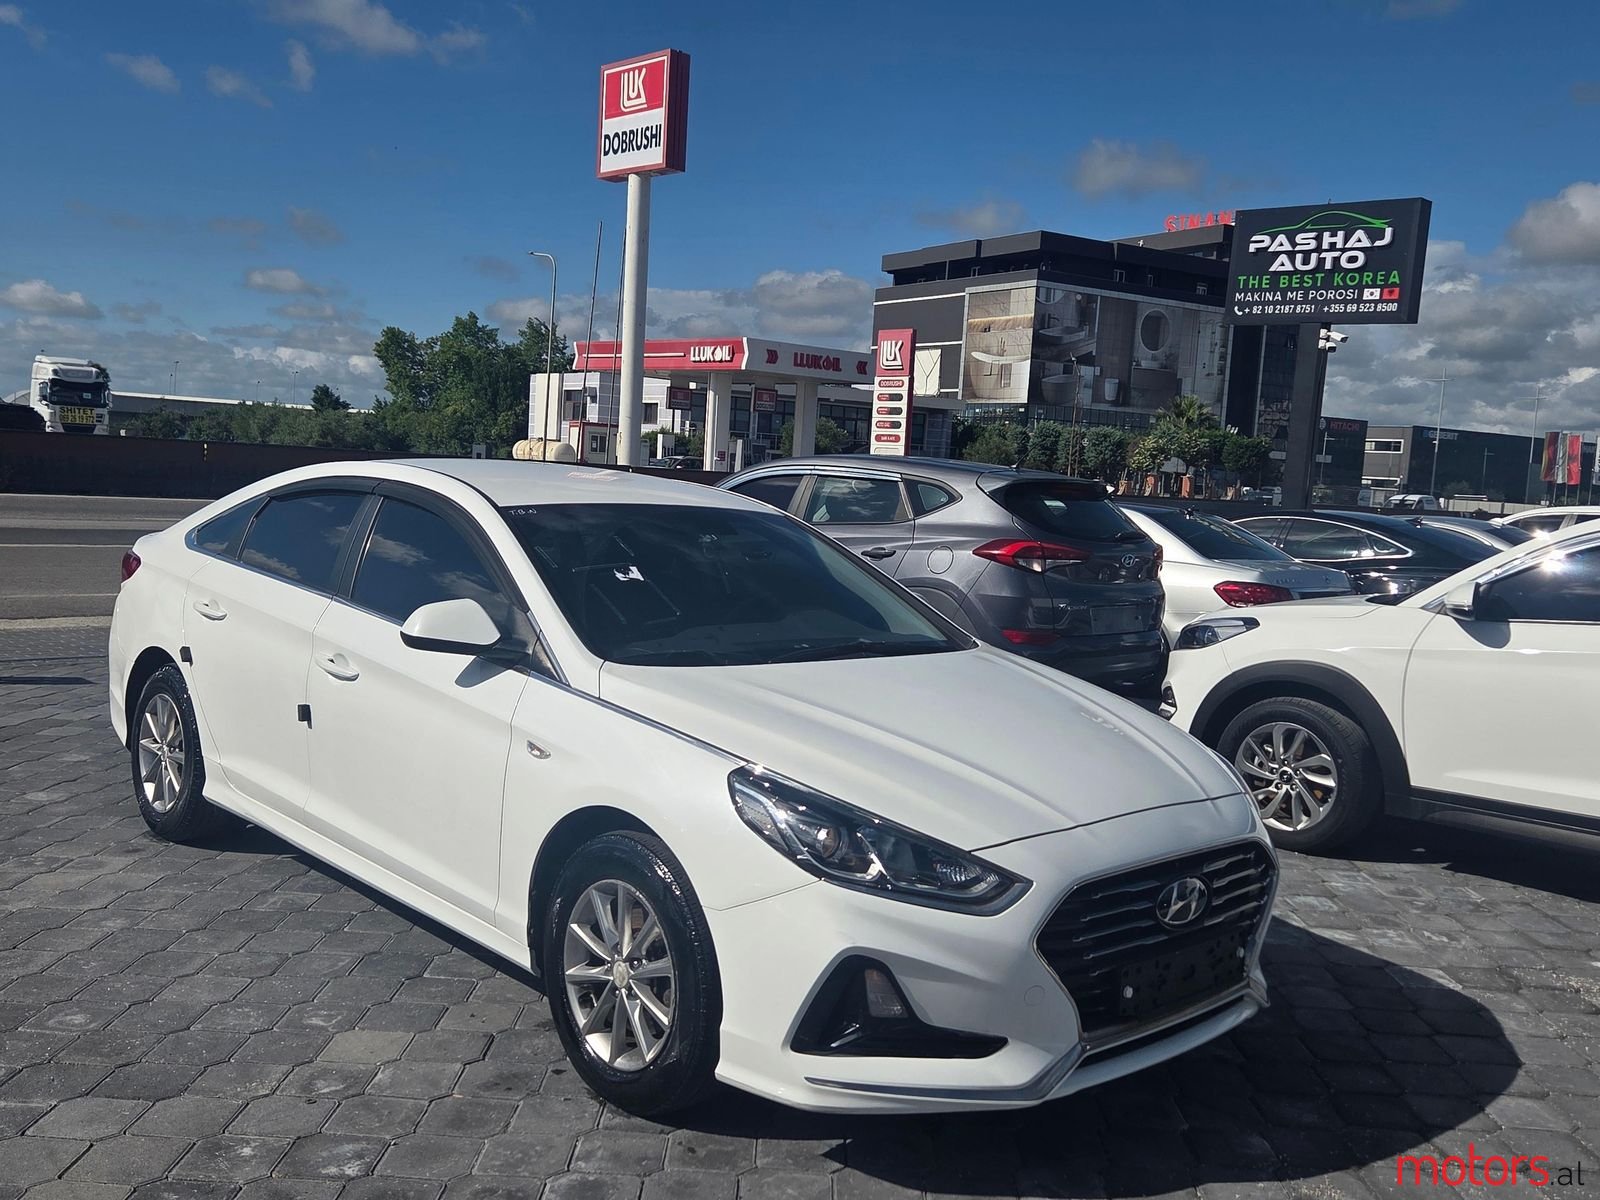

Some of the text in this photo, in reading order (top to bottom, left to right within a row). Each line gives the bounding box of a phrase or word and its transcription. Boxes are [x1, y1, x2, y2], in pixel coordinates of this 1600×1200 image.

[603, 124, 662, 156] DOBRUSHI
[1248, 227, 1393, 253] PASHAJ
[1268, 250, 1366, 272] AUTO
[1238, 270, 1400, 289] THE BEST KOREA
[1234, 289, 1358, 302] MAKINA ME POROSI
[1252, 305, 1262, 314] 82
[1264, 305, 1274, 314] 10
[1275, 304, 1294, 314] 2187
[1295, 304, 1315, 314] 8751
[1346, 303, 1357, 313] 69
[1358, 303, 1375, 313] 523
[1376, 302, 1398, 312] 8500
[59, 406, 94, 415] SHITET
[1330, 421, 1360, 431] HITACHI
